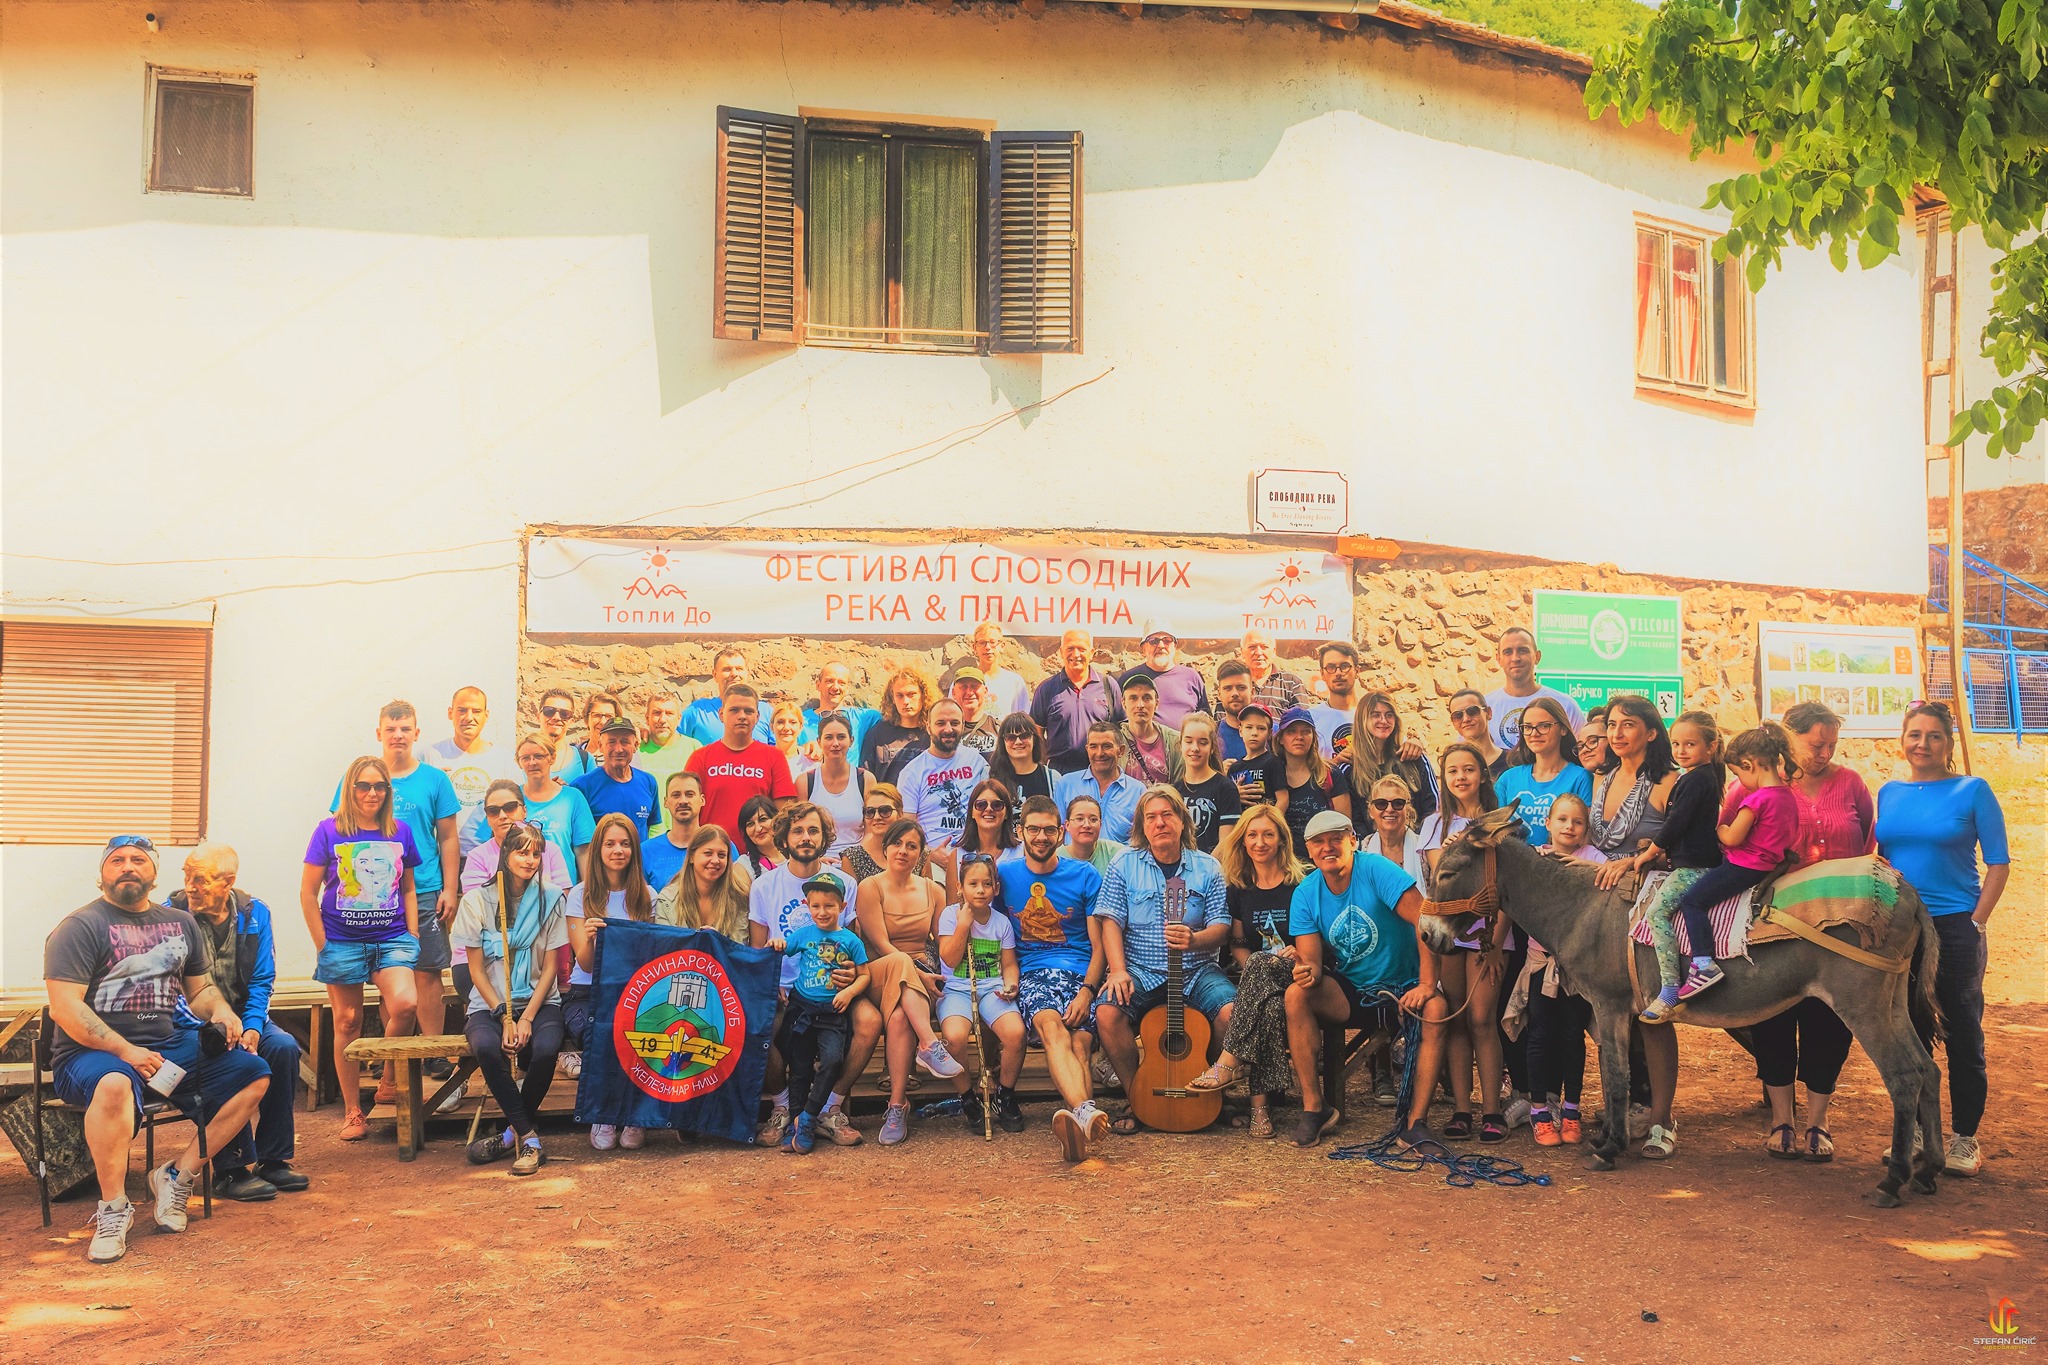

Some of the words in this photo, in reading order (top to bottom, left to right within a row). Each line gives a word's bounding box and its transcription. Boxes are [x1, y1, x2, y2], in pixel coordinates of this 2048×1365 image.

[1269, 492, 1314, 504] СЛОБОДНИХ
[1318, 493, 1336, 504] РЕКА
[765, 554, 956, 582] ФЕСТИВАЛ
[970, 555, 1192, 592] СЛОБОДНИХ
[602, 606, 674, 624] Топли
[684, 606, 711, 627] До
[826, 594, 912, 621] РЕКА
[924, 594, 946, 622] &
[960, 594, 1134, 625] ПЛАНИНА
[1242, 614, 1306, 630] Топли
[1316, 615, 1334, 634] До
[1630, 617, 1676, 632] WELCOME
[1569, 684, 1602, 702] Јабучко
[708, 763, 764, 778] adidas
[927, 766, 974, 786] BOMB
[1249, 769, 1264, 780] THE
[1518, 804, 1550, 815] ТОПЛ
[624, 955, 722, 1010] ПЛАНИНАРСКИ
[720, 986, 741, 1028] КЛУБ
[638, 1037, 657, 1053] 19
[630, 1062, 690, 1096] ЖЕЛЕЗНИЧАР
[692, 1073, 719, 1092] НИШ
